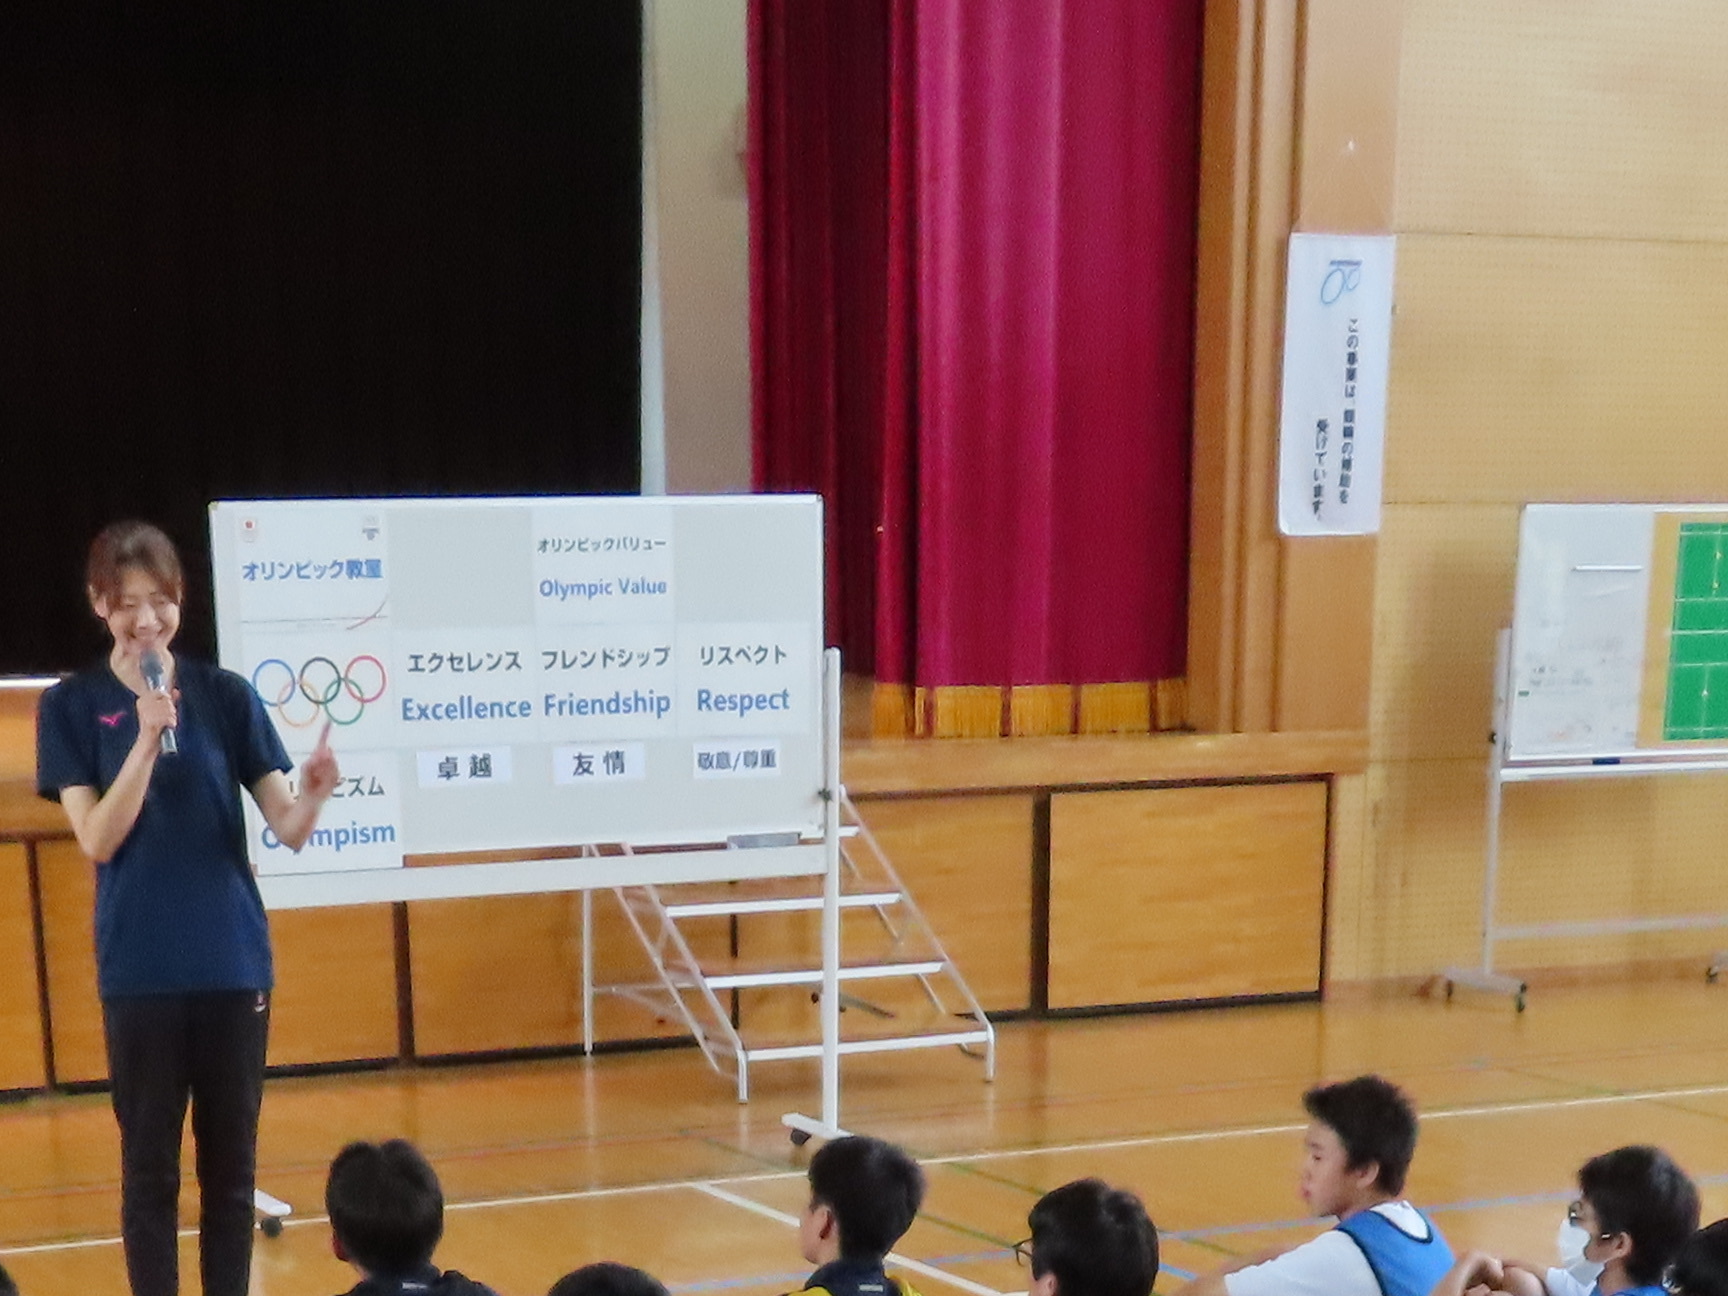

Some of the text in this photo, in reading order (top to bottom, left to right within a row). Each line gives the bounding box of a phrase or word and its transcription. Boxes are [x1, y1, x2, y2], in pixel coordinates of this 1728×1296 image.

[537, 537, 667, 553] オリンピックバリュー
[539, 576, 667, 601] Olympic Value
[407, 651, 523, 673] エクセレンス
[541, 646, 671, 671] フレンドシップ
[700, 644, 787, 666] リスペクト
[401, 695, 532, 721] Excellence
[543, 688, 671, 720] Friendship
[697, 688, 790, 718] Respect
[572, 750, 626, 776] 友情
[262, 821, 396, 855] Ompism
